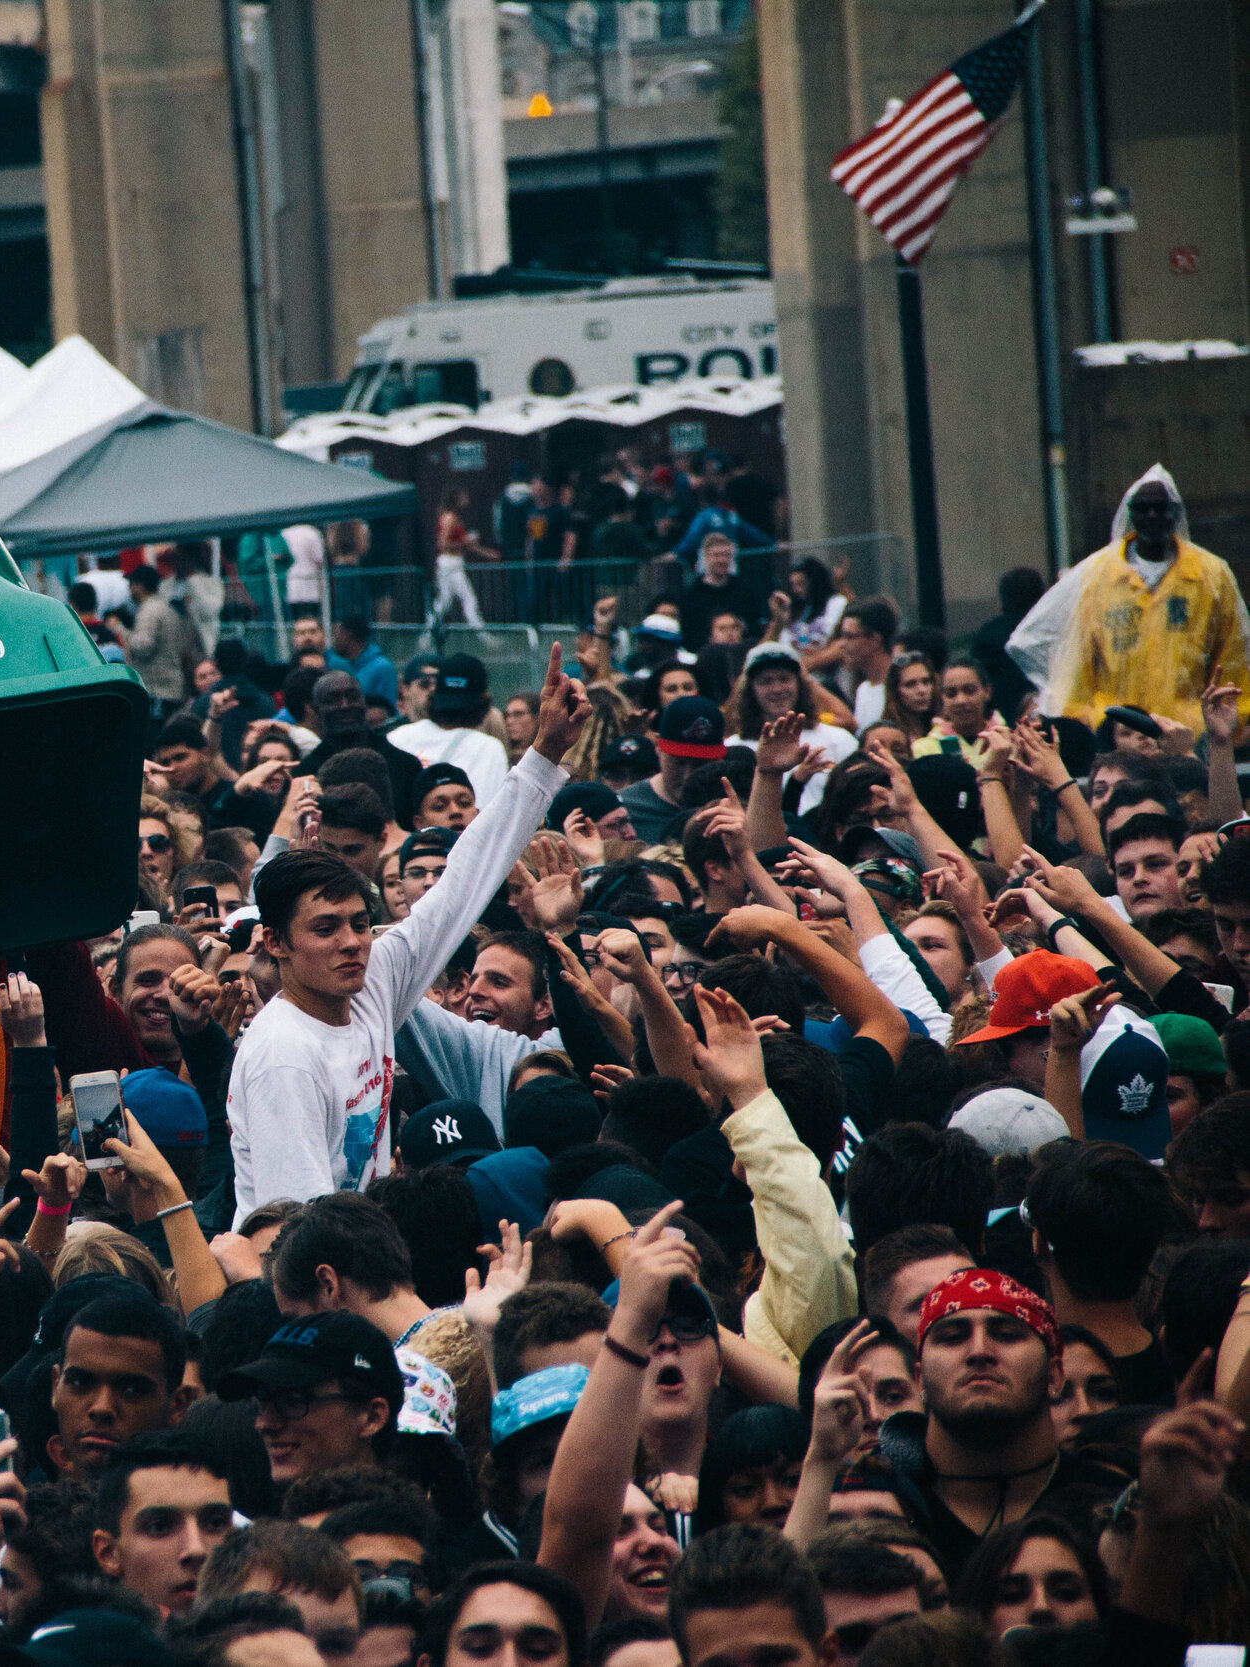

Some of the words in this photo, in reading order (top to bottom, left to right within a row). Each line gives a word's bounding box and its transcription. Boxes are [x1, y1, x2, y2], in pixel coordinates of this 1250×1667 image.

[680, 322, 737, 344] CITY
[431, 1114, 463, 1145] NY
[518, 1391, 570, 1416] Supreme
